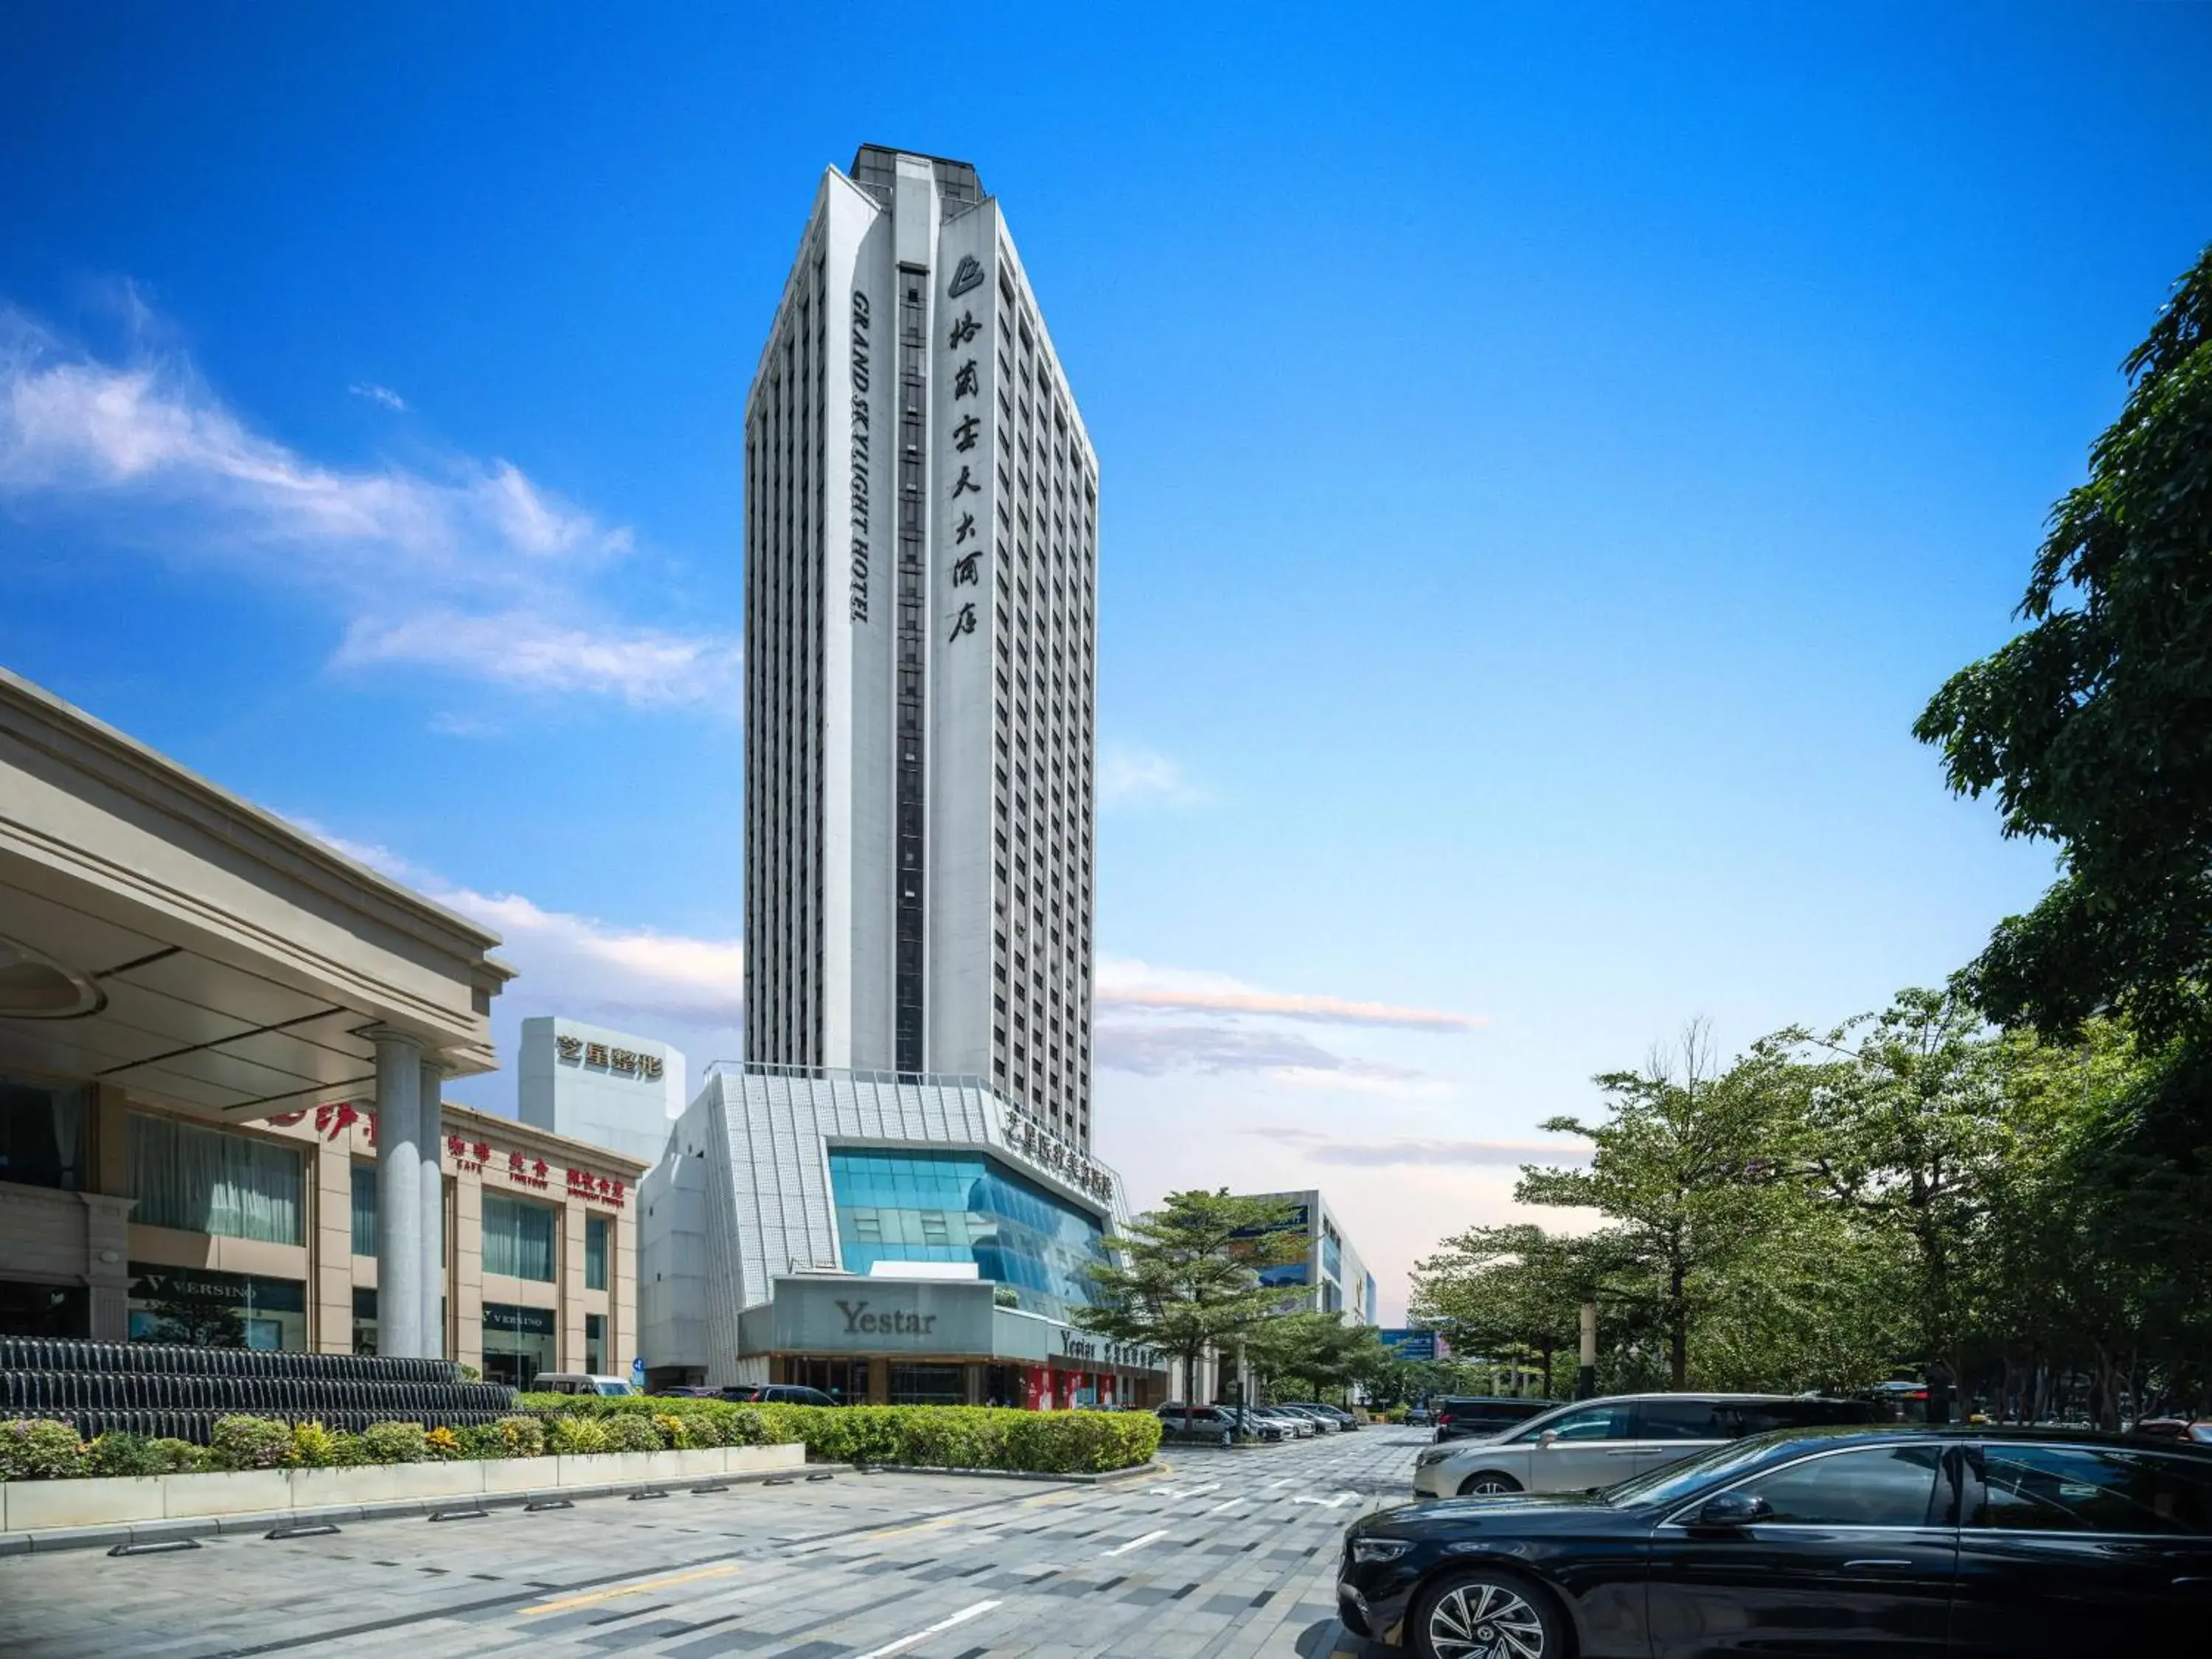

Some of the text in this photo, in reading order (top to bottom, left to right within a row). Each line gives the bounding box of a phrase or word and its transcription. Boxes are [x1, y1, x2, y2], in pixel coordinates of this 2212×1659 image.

[851, 290, 869, 624] GRAND SKYLIGHT HOTEL
[557, 1035, 664, 1077] 艺星整形
[173, 1280, 257, 1299] VERSINO
[835, 1301, 936, 1335] Yestar
